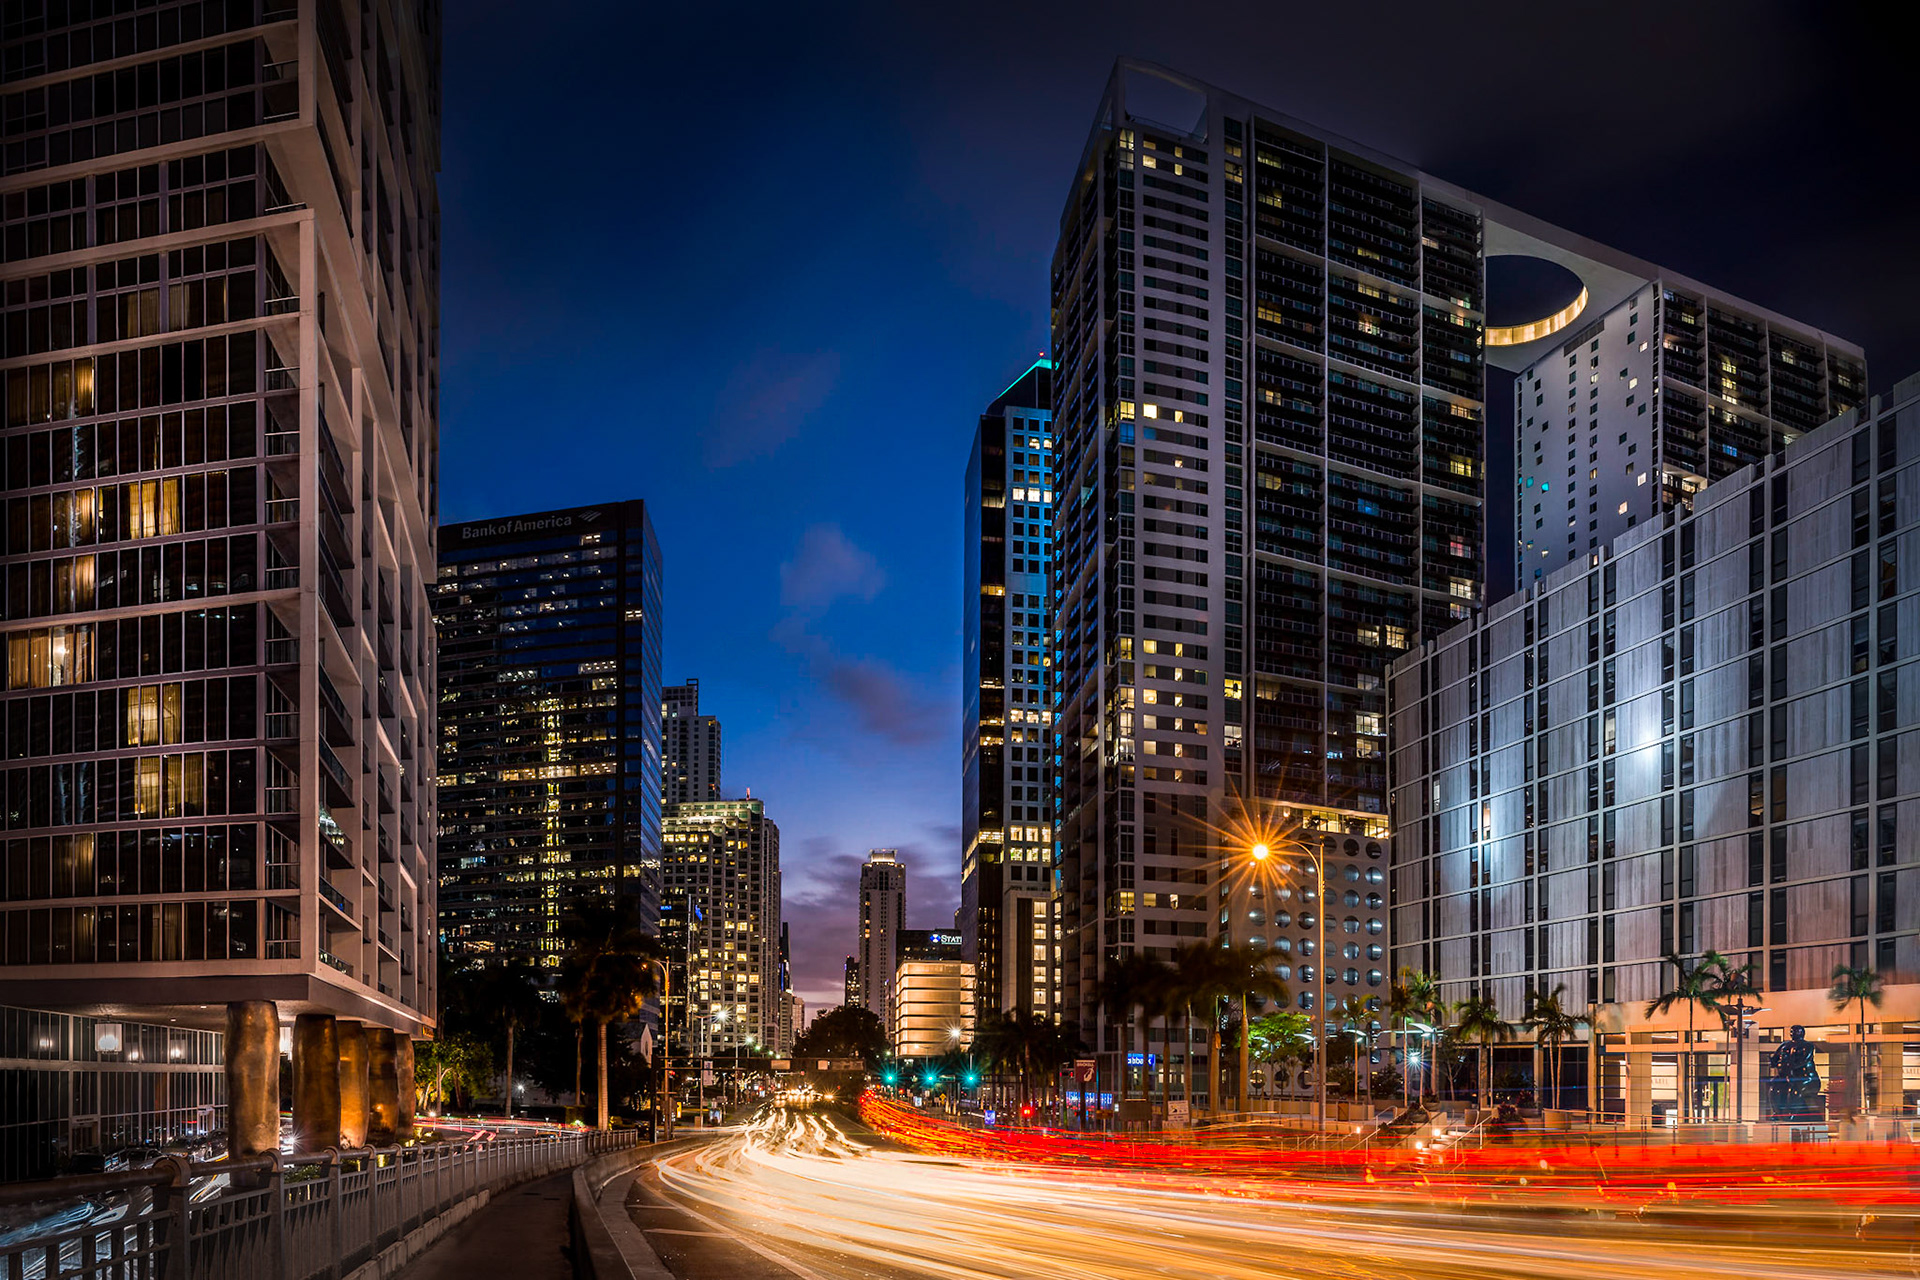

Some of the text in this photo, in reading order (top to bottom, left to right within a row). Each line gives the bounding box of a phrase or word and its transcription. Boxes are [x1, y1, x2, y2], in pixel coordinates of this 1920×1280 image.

[462, 515, 572, 540] Bank of America
[941, 935, 962, 943] STAT
